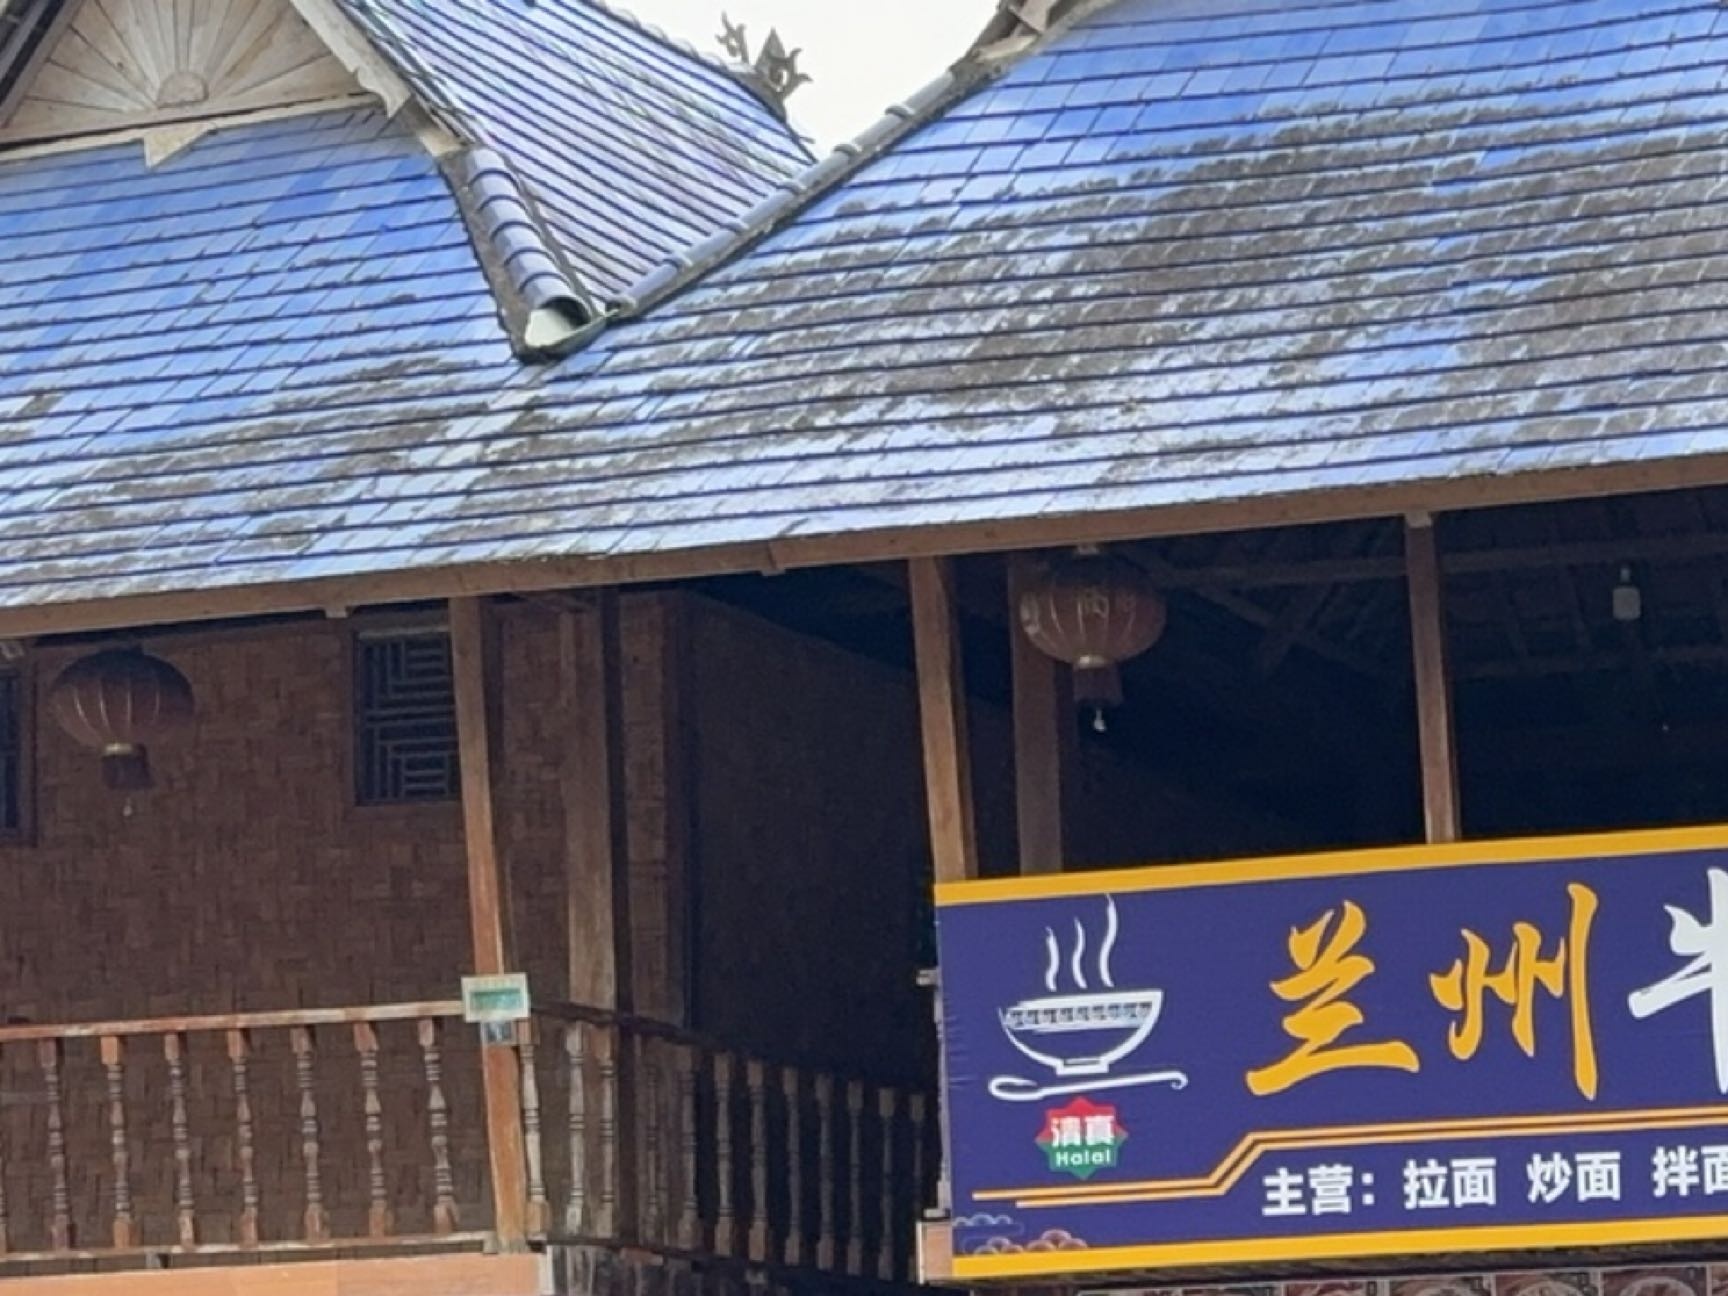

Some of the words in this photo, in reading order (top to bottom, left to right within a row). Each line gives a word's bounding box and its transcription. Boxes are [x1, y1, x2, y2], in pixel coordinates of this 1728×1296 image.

[1056, 1150, 1111, 1166] Halal
[1403, 1157, 1497, 1210] 拉面
[1526, 1151, 1622, 1203] 炒面
